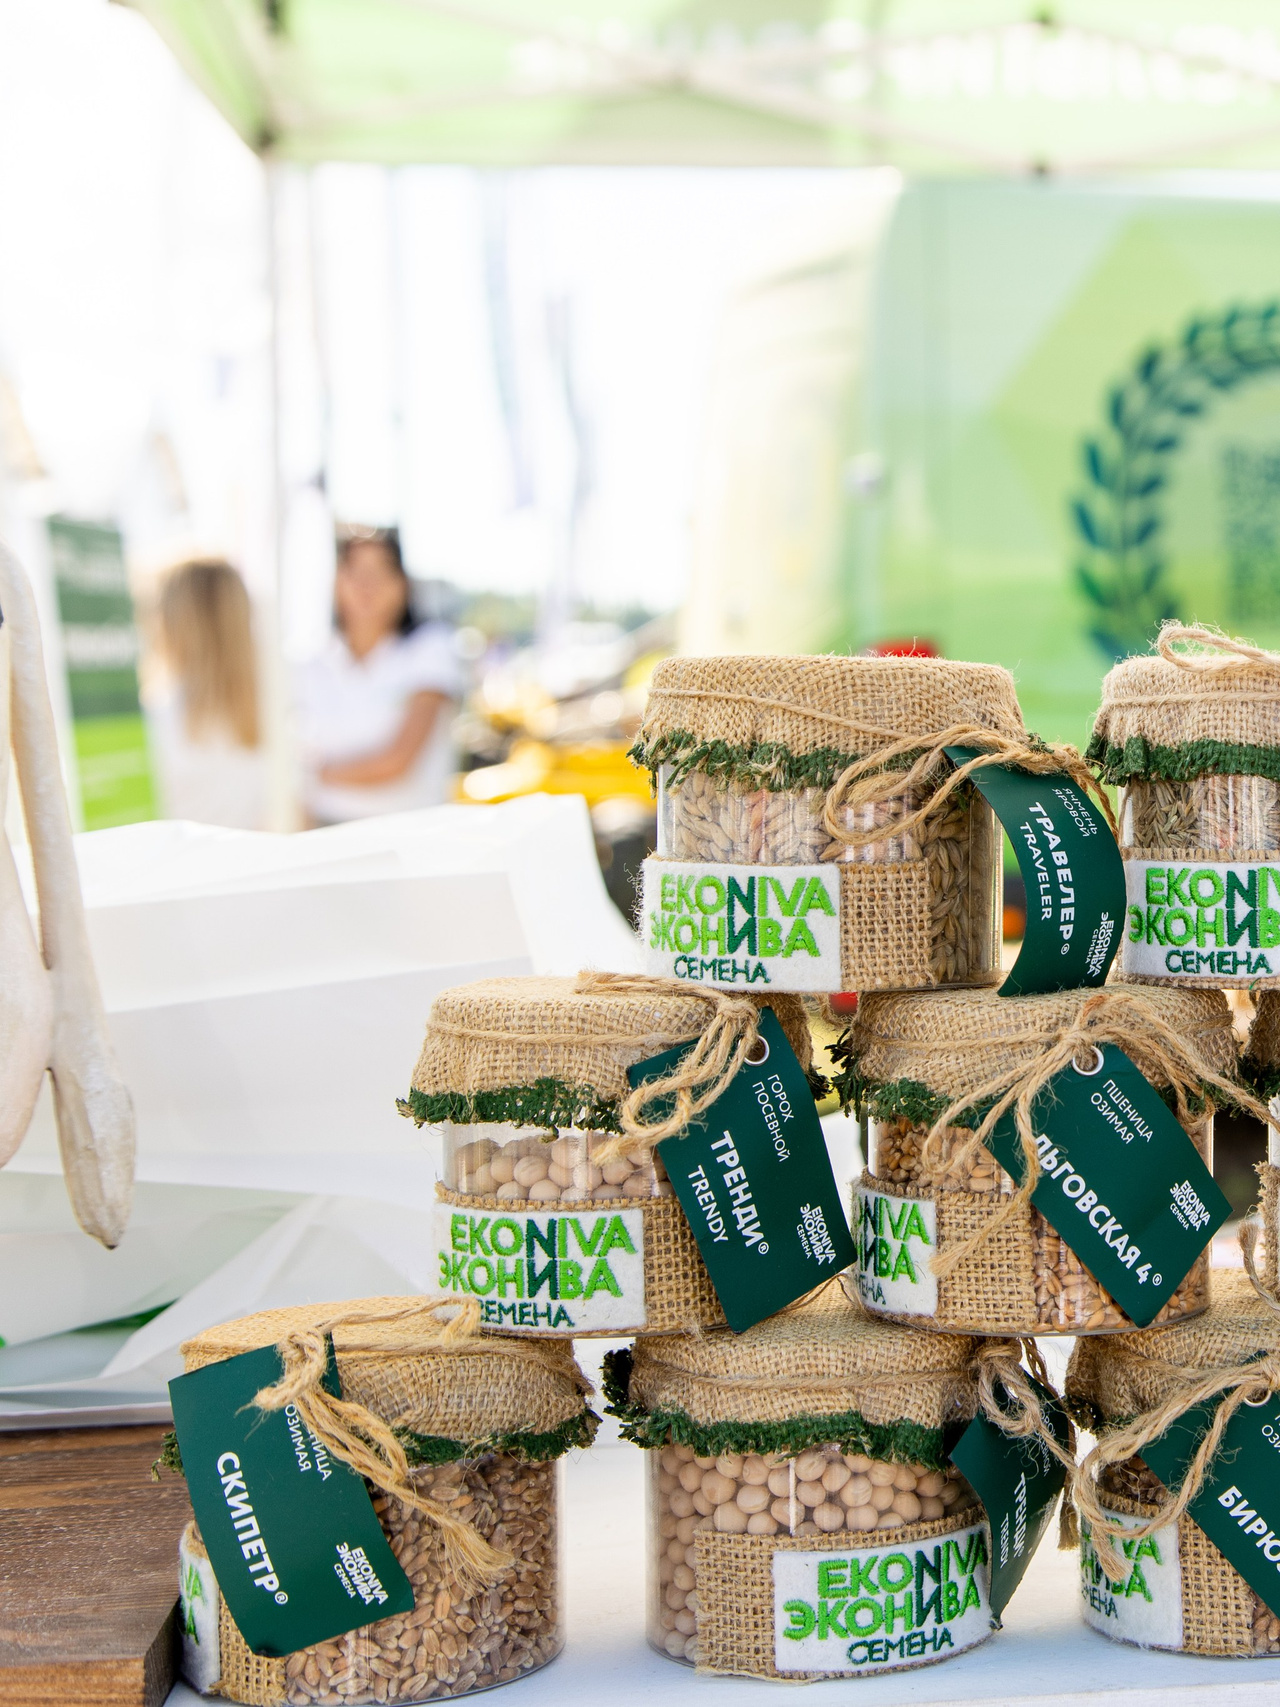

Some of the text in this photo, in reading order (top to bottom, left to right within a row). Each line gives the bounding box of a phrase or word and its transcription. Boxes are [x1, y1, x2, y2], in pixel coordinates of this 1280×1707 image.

[1051, 788, 1090, 837] ЯРОВОЙ
[1062, 787, 1098, 835] ЯЧМЕНЬ
[661, 873, 836, 917] EKONIVA
[1020, 822, 1053, 921] TRAVELER
[650, 911, 820, 958] ЭКОНИВА
[674, 955, 771, 983] СЕМЕНА
[1165, 950, 1273, 975] СЕМЕНА
[752, 1081, 791, 1163] ПОСЕВНОЙ
[767, 1073, 795, 1122] ГОРОХ
[1090, 1092, 1135, 1145] ОЗИМАЯ
[1102, 1079, 1154, 1143] ПШЕНИЦА
[687, 1165, 729, 1244] TRENDY
[1169, 1182, 1203, 1232] ЭКОНИВА
[1169, 1202, 1190, 1231] СЕМЕНА
[1179, 1179, 1211, 1227] EKONIVA
[450, 1213, 638, 1259] EKONIVA
[796, 1223, 812, 1260] СЕМЕНА
[799, 1202, 826, 1266] ЭКОНИВА
[810, 1205, 837, 1265] EKONIVA
[438, 1252, 623, 1300] ЭКОНИВА
[285, 1404, 312, 1472] ОЗИМАЯ
[333, 1563, 356, 1599] СЕМЕНА
[336, 1542, 375, 1606] ЭКОНИВА
[351, 1547, 388, 1605] EKONIVA
[817, 1531, 988, 1598] EKONIVA
[782, 1573, 981, 1640] ЭКОНИВА
[848, 1628, 954, 1665] СЕМЕНА
